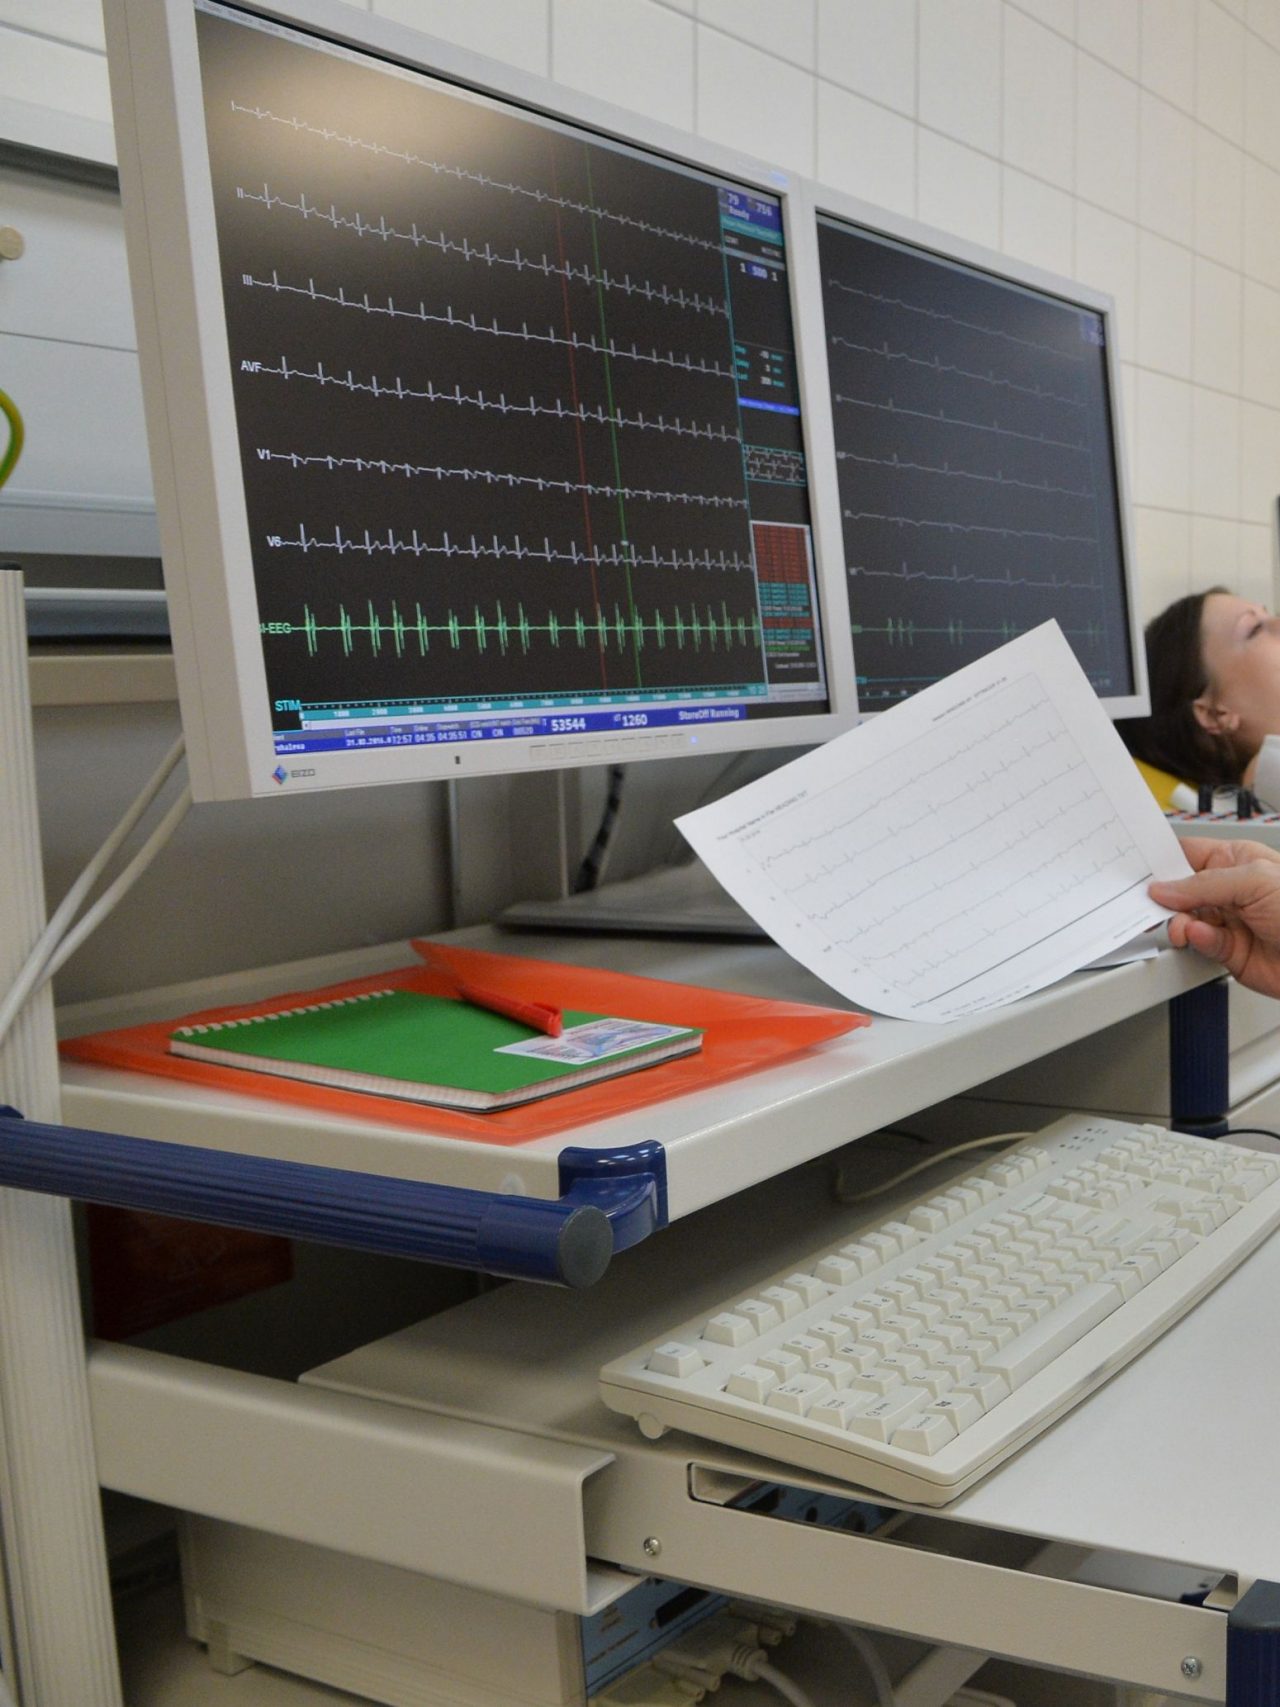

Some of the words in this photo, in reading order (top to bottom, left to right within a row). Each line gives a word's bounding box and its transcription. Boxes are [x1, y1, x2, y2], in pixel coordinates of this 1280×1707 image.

[236, 187, 244, 198] II
[242, 274, 253, 286] III
[241, 360, 262, 373] AVF
[257, 449, 271, 460] V1
[267, 535, 281, 547] V6
[275, 700, 300, 711] STIM
[711, 707, 740, 719] Running
[551, 717, 587, 732] 53544
[622, 713, 648, 727] 1260
[291, 768, 316, 778] EIZO
